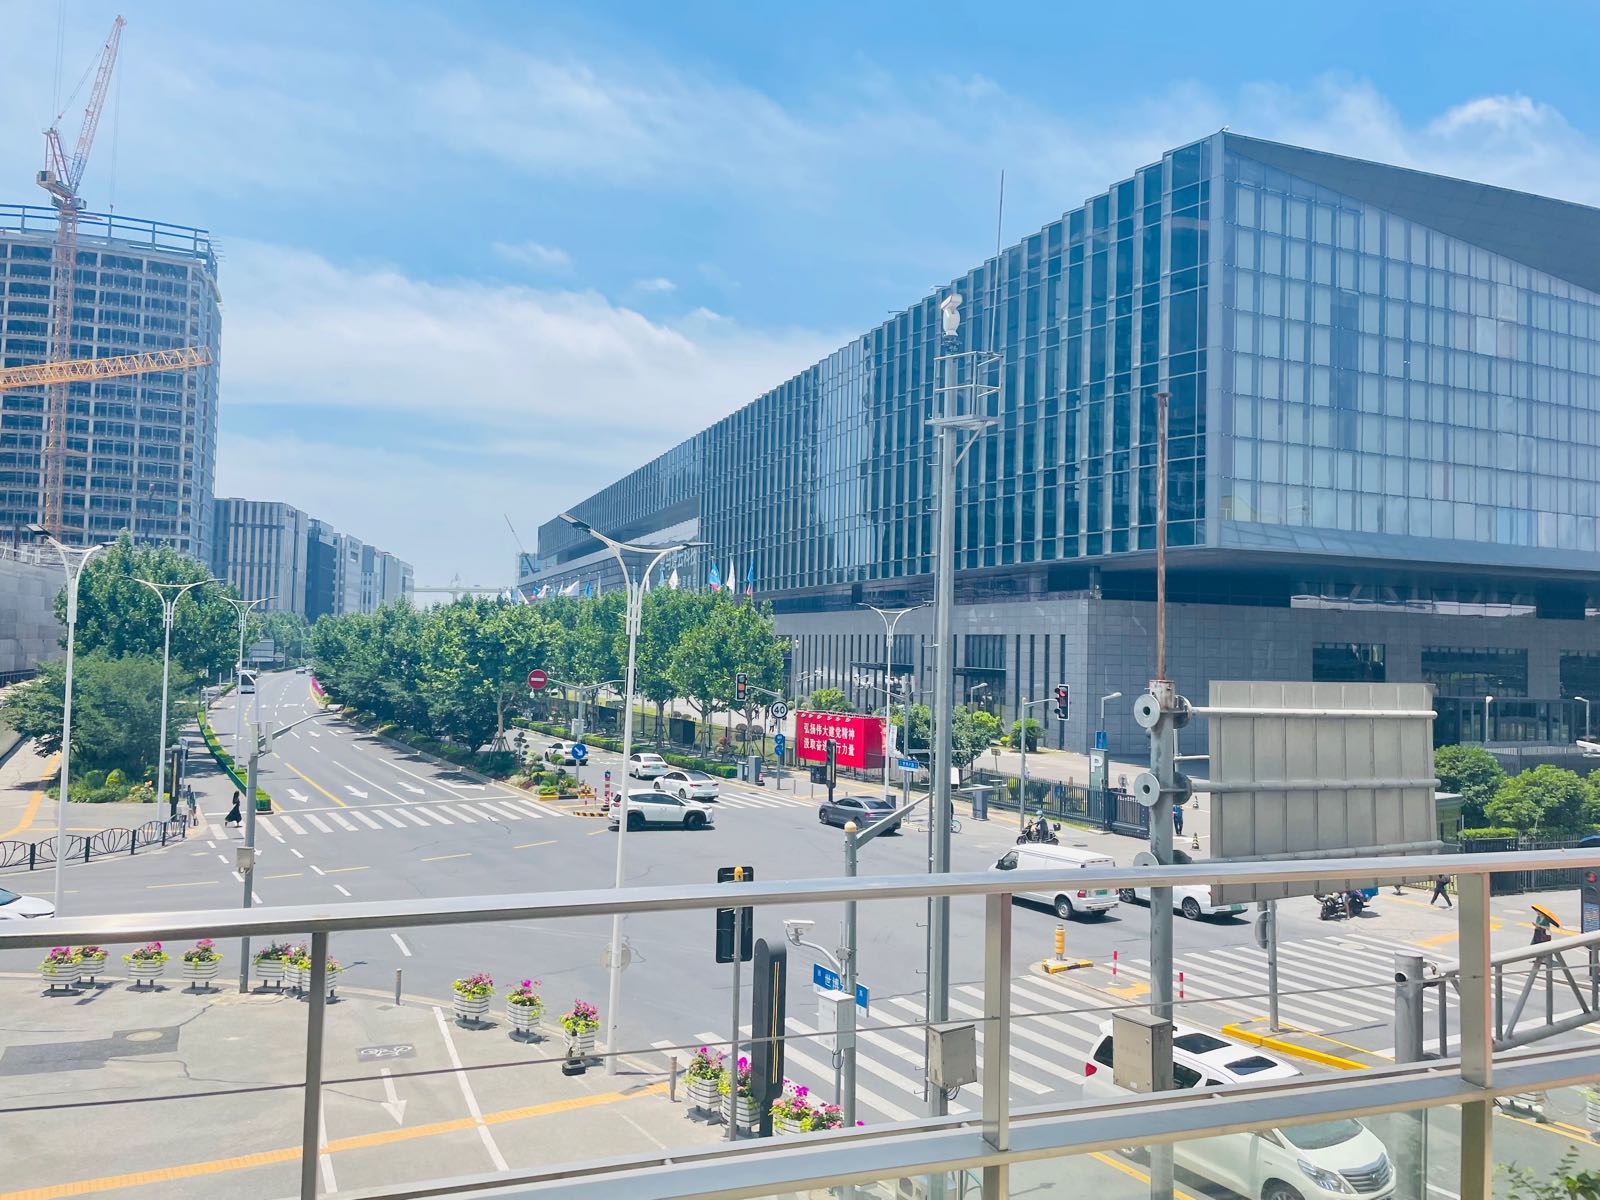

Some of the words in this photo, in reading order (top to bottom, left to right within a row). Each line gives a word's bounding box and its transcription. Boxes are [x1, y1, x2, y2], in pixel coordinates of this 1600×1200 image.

[774, 706, 785, 714] 40
[803, 723, 855, 740] 弘扬伟大建党精神
[803, 737, 855, 757] 汲取奋进行力量
[1090, 755, 1104, 773] P
